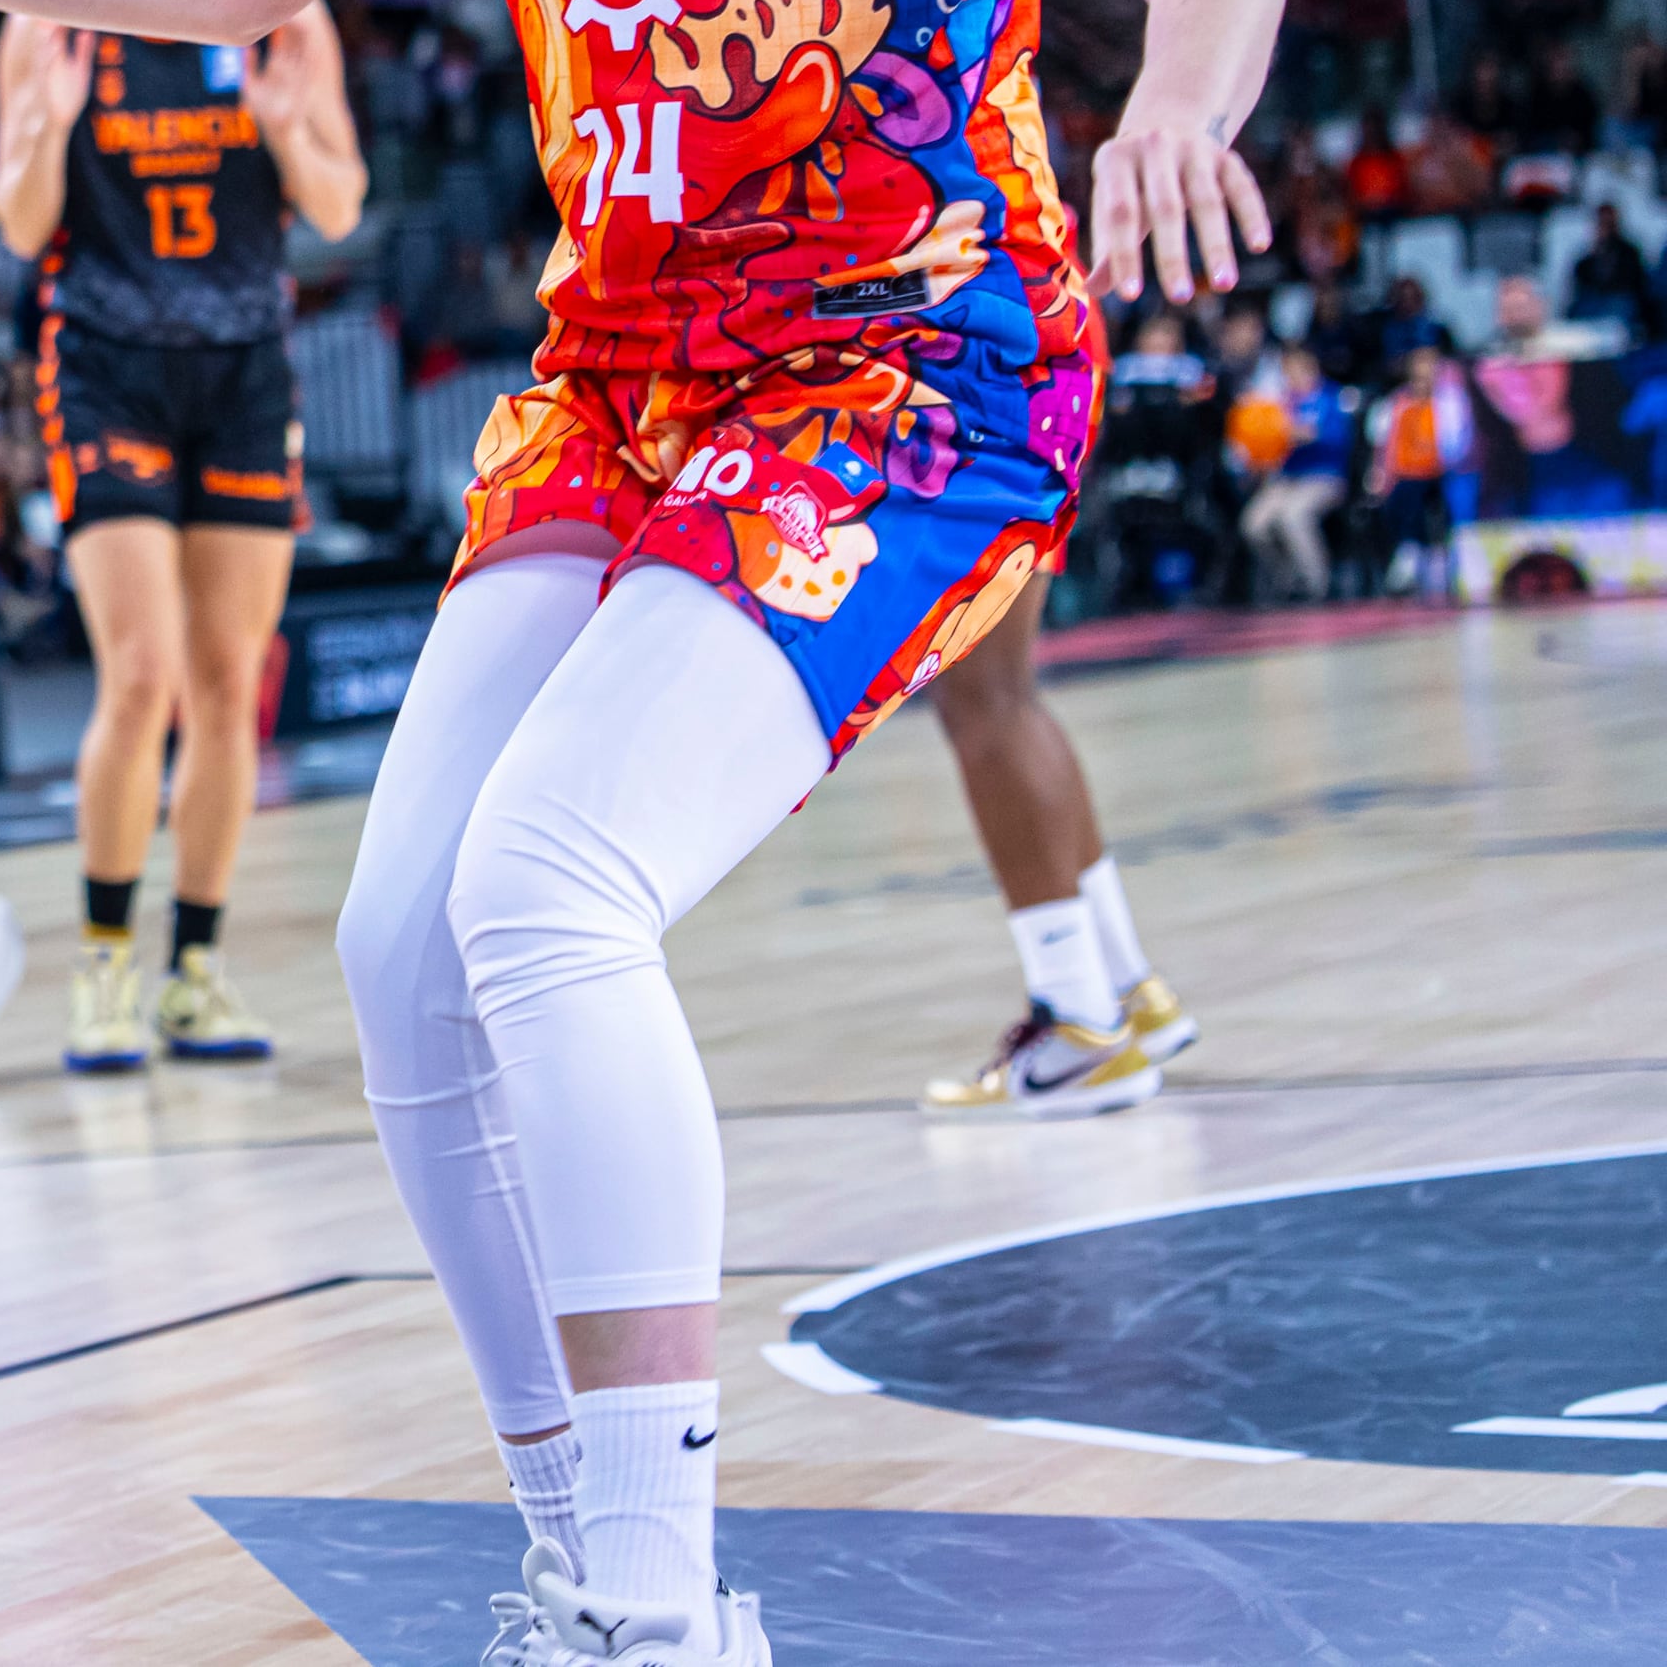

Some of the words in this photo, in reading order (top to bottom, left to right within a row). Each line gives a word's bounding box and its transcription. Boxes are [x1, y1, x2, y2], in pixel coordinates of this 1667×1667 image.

[92, 105, 259, 155] VALENCIA
[574, 102, 685, 227] 14
[144, 184, 217, 259] 13
[857, 282, 890, 297] 2XL
